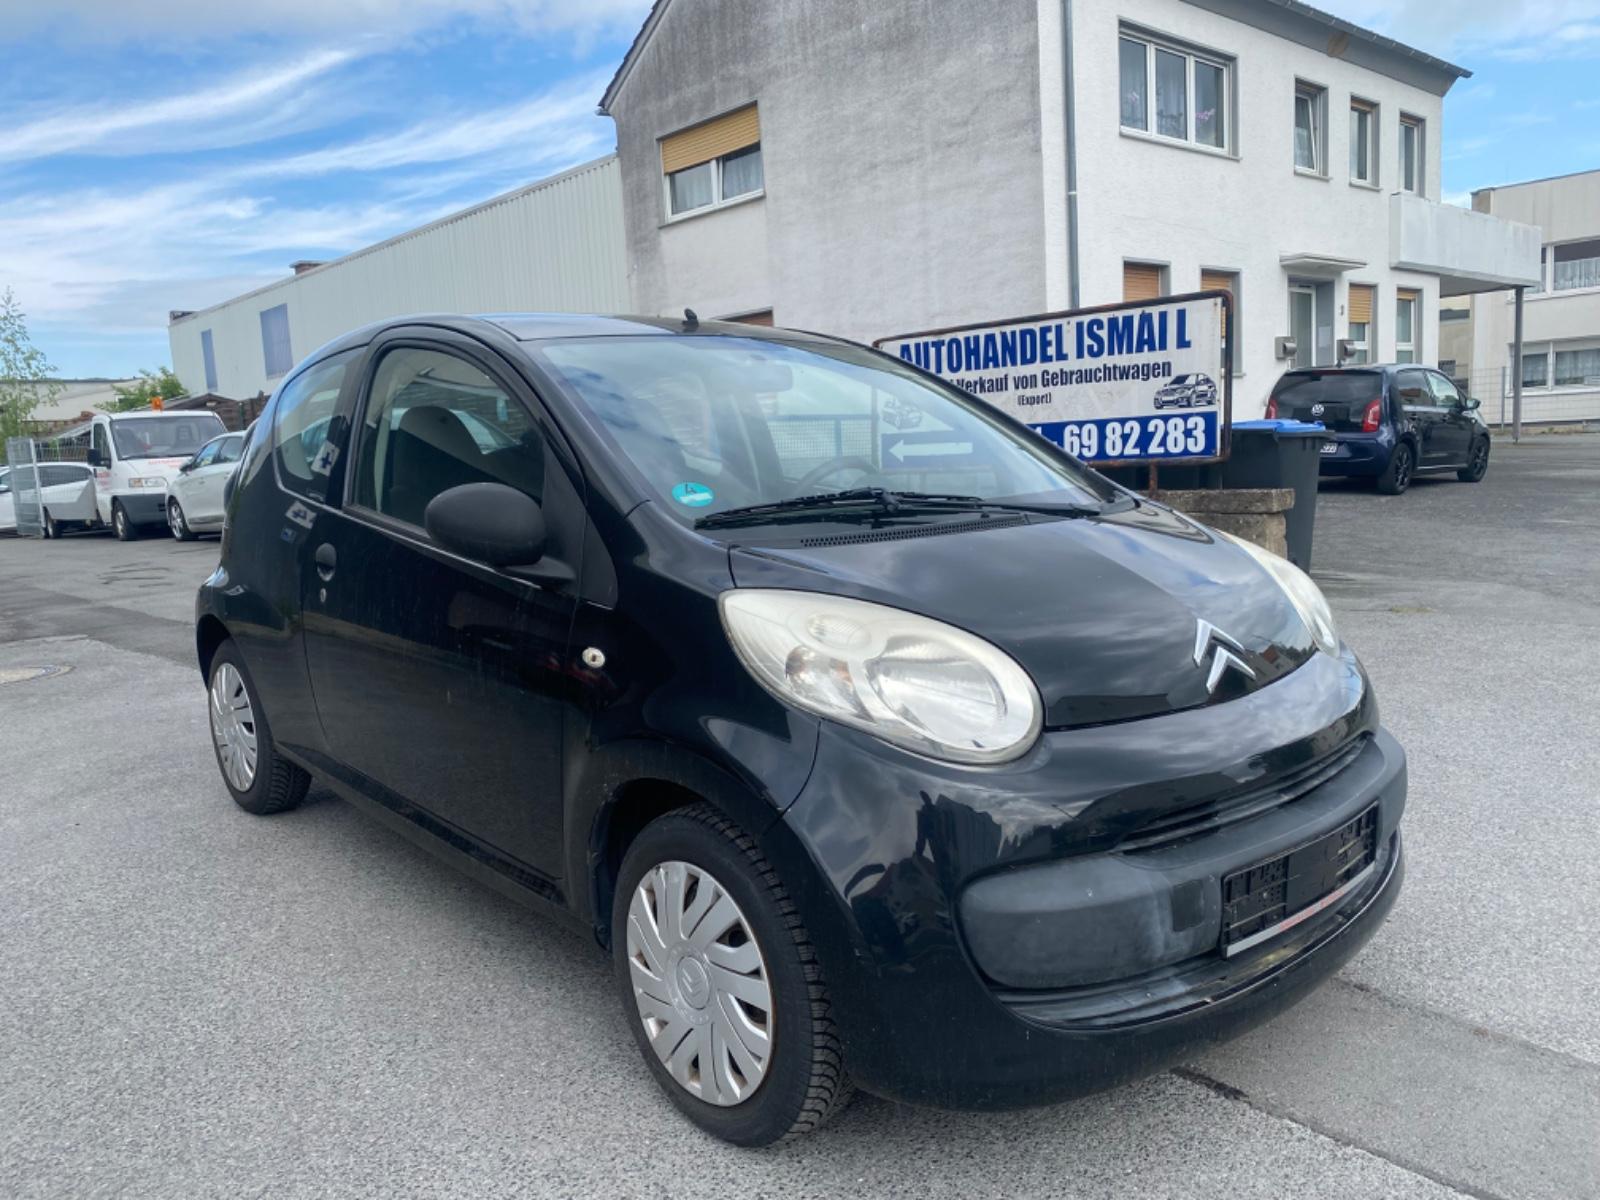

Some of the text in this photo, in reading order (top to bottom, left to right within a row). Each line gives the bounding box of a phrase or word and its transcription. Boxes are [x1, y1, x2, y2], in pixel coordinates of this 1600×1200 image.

[1013, 373, 1038, 390] von
[1041, 361, 1172, 388] Gebrauchtwagen
[1017, 392, 1052, 406] (Export)
[1063, 423, 1098, 458] 69
[1105, 420, 1141, 457] 82
[1147, 416, 1206, 454] 283
